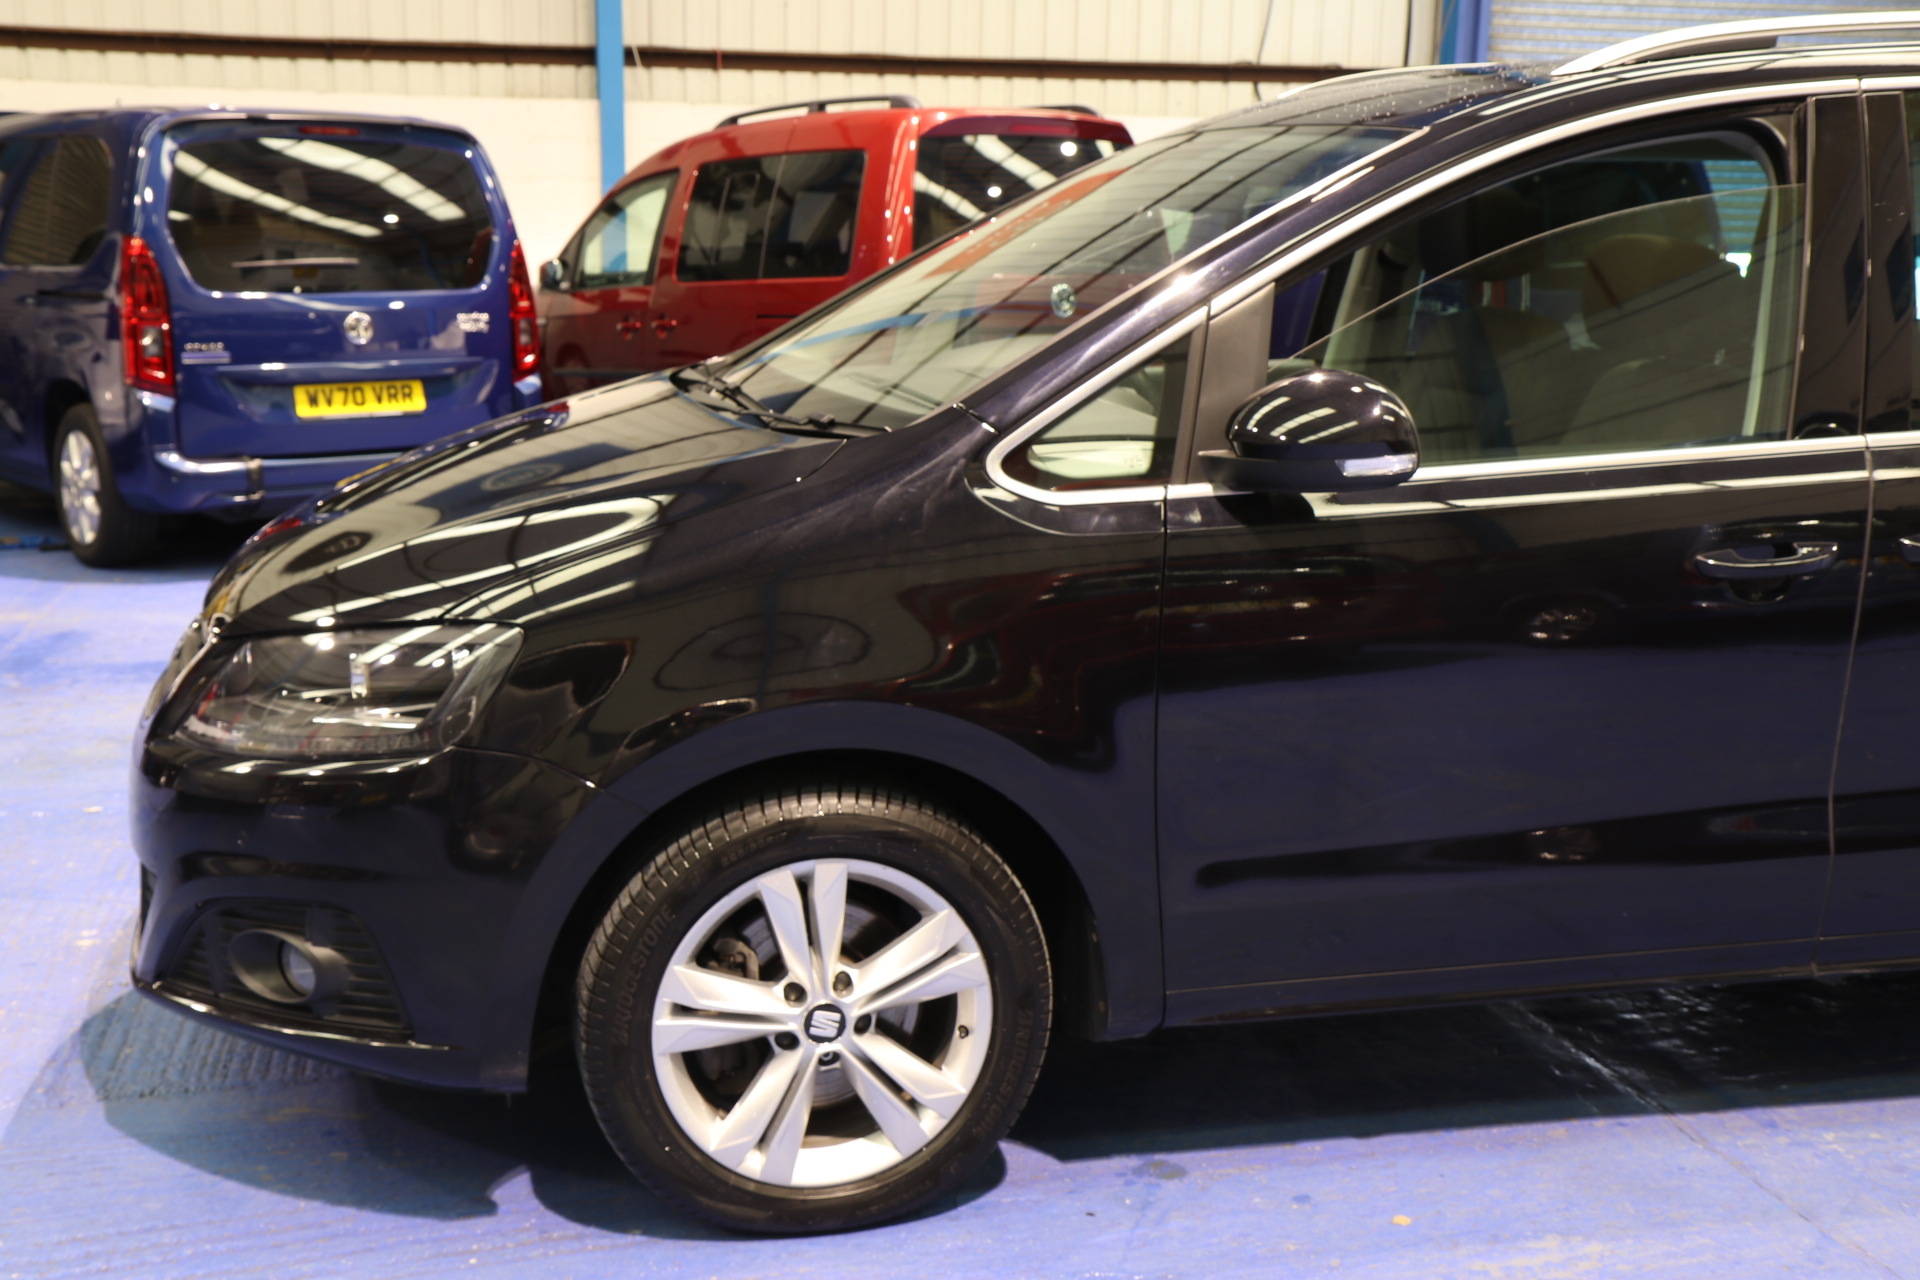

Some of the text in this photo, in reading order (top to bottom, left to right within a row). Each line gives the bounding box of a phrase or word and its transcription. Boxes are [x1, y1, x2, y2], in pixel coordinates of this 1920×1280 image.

[305, 383, 413, 408] WV70 VRR
[612, 904, 674, 1046] BRIDGESTONE
